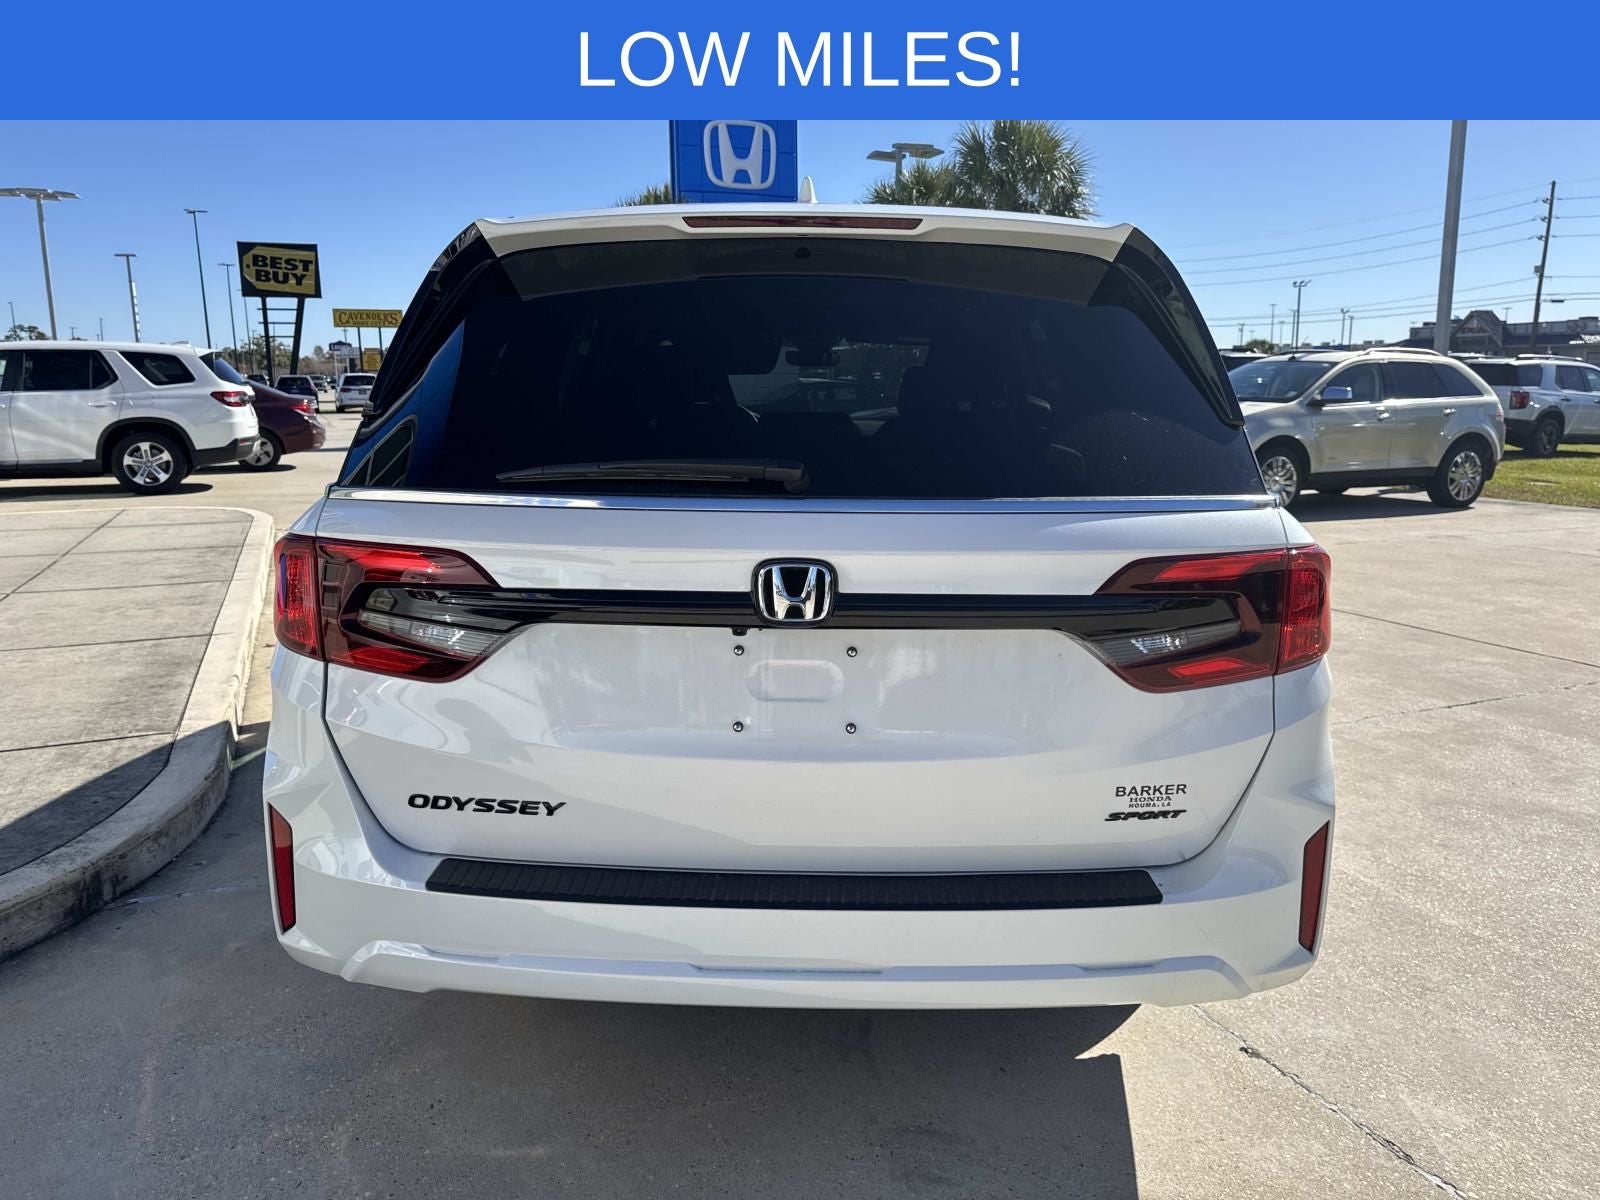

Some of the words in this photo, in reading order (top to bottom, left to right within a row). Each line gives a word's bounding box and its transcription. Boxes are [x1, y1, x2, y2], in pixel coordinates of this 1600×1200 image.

[252, 254, 313, 272] BEST
[255, 269, 308, 286] BUY
[1115, 784, 1187, 797] BARKER
[407, 793, 567, 817] ODYSSEY
[1104, 809, 1187, 821] SPORT
